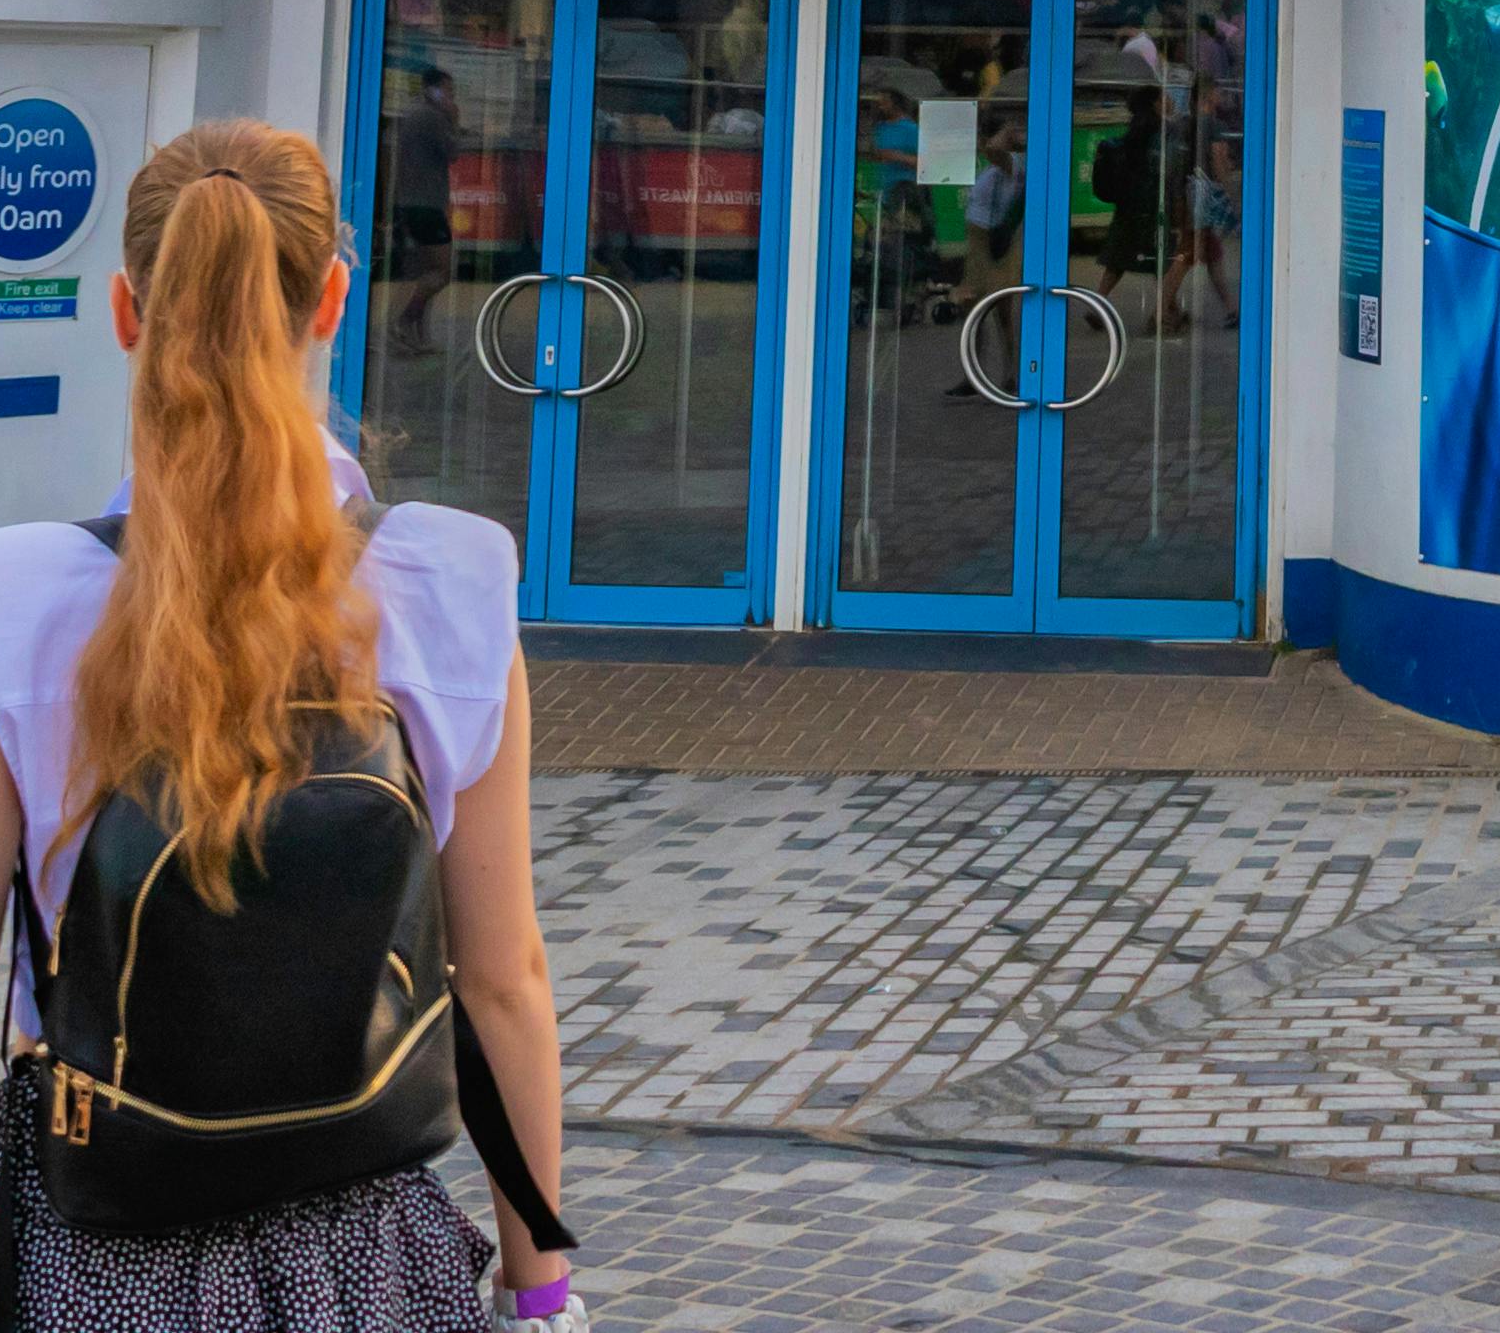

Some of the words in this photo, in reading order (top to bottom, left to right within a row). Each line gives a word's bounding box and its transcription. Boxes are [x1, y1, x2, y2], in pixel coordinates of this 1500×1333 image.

[30, 164, 92, 188] from
[4, 283, 31, 296] Fire
[34, 282, 60, 295] exit
[32, 301, 63, 314] clear
